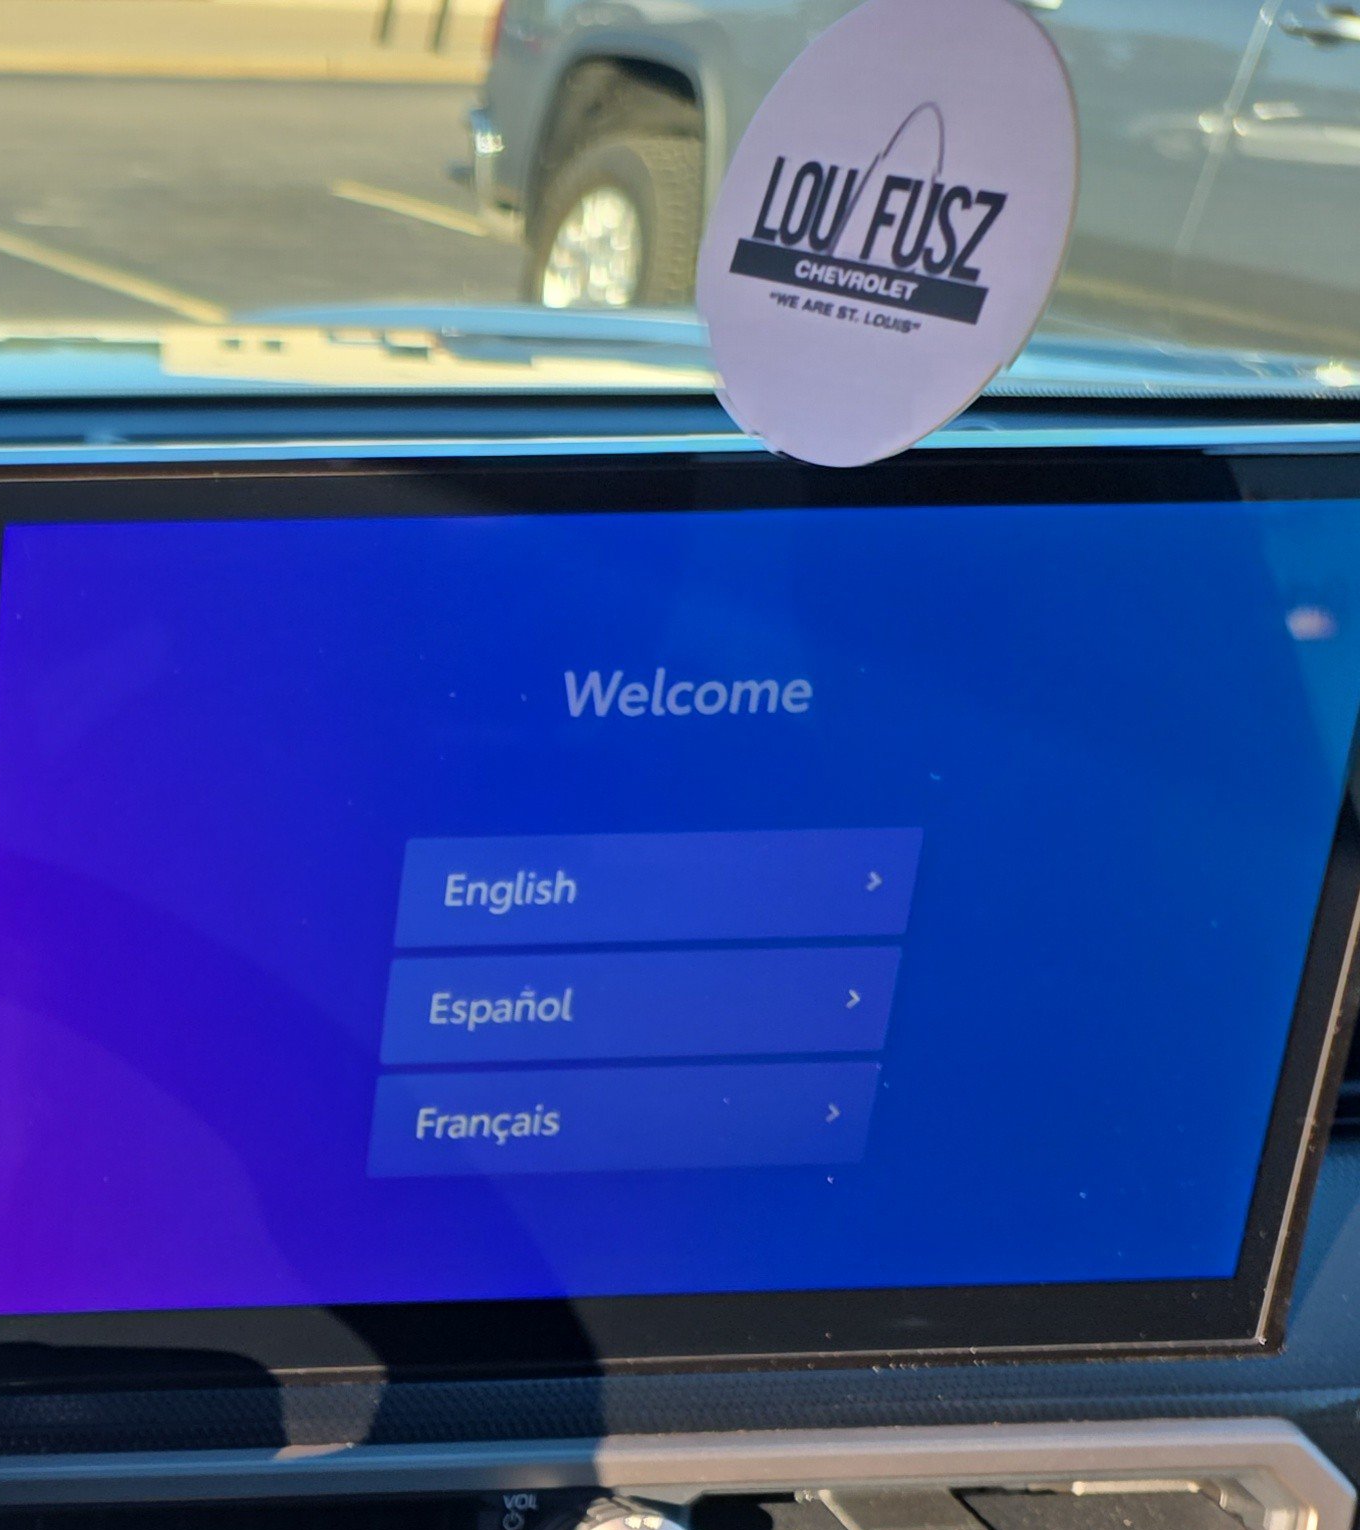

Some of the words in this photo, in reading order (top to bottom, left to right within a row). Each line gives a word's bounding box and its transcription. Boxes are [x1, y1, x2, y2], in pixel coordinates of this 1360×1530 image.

[753, 156, 858, 251] LOU
[860, 175, 1008, 282] FUSZ
[794, 259, 918, 301] CHEVROLET
[802, 298, 834, 316] ARE
[837, 306, 860, 322] ST.
[564, 668, 812, 717] Welcome
[443, 870, 576, 914] English
[429, 986, 574, 1030] Español
[415, 1105, 560, 1144] Français
